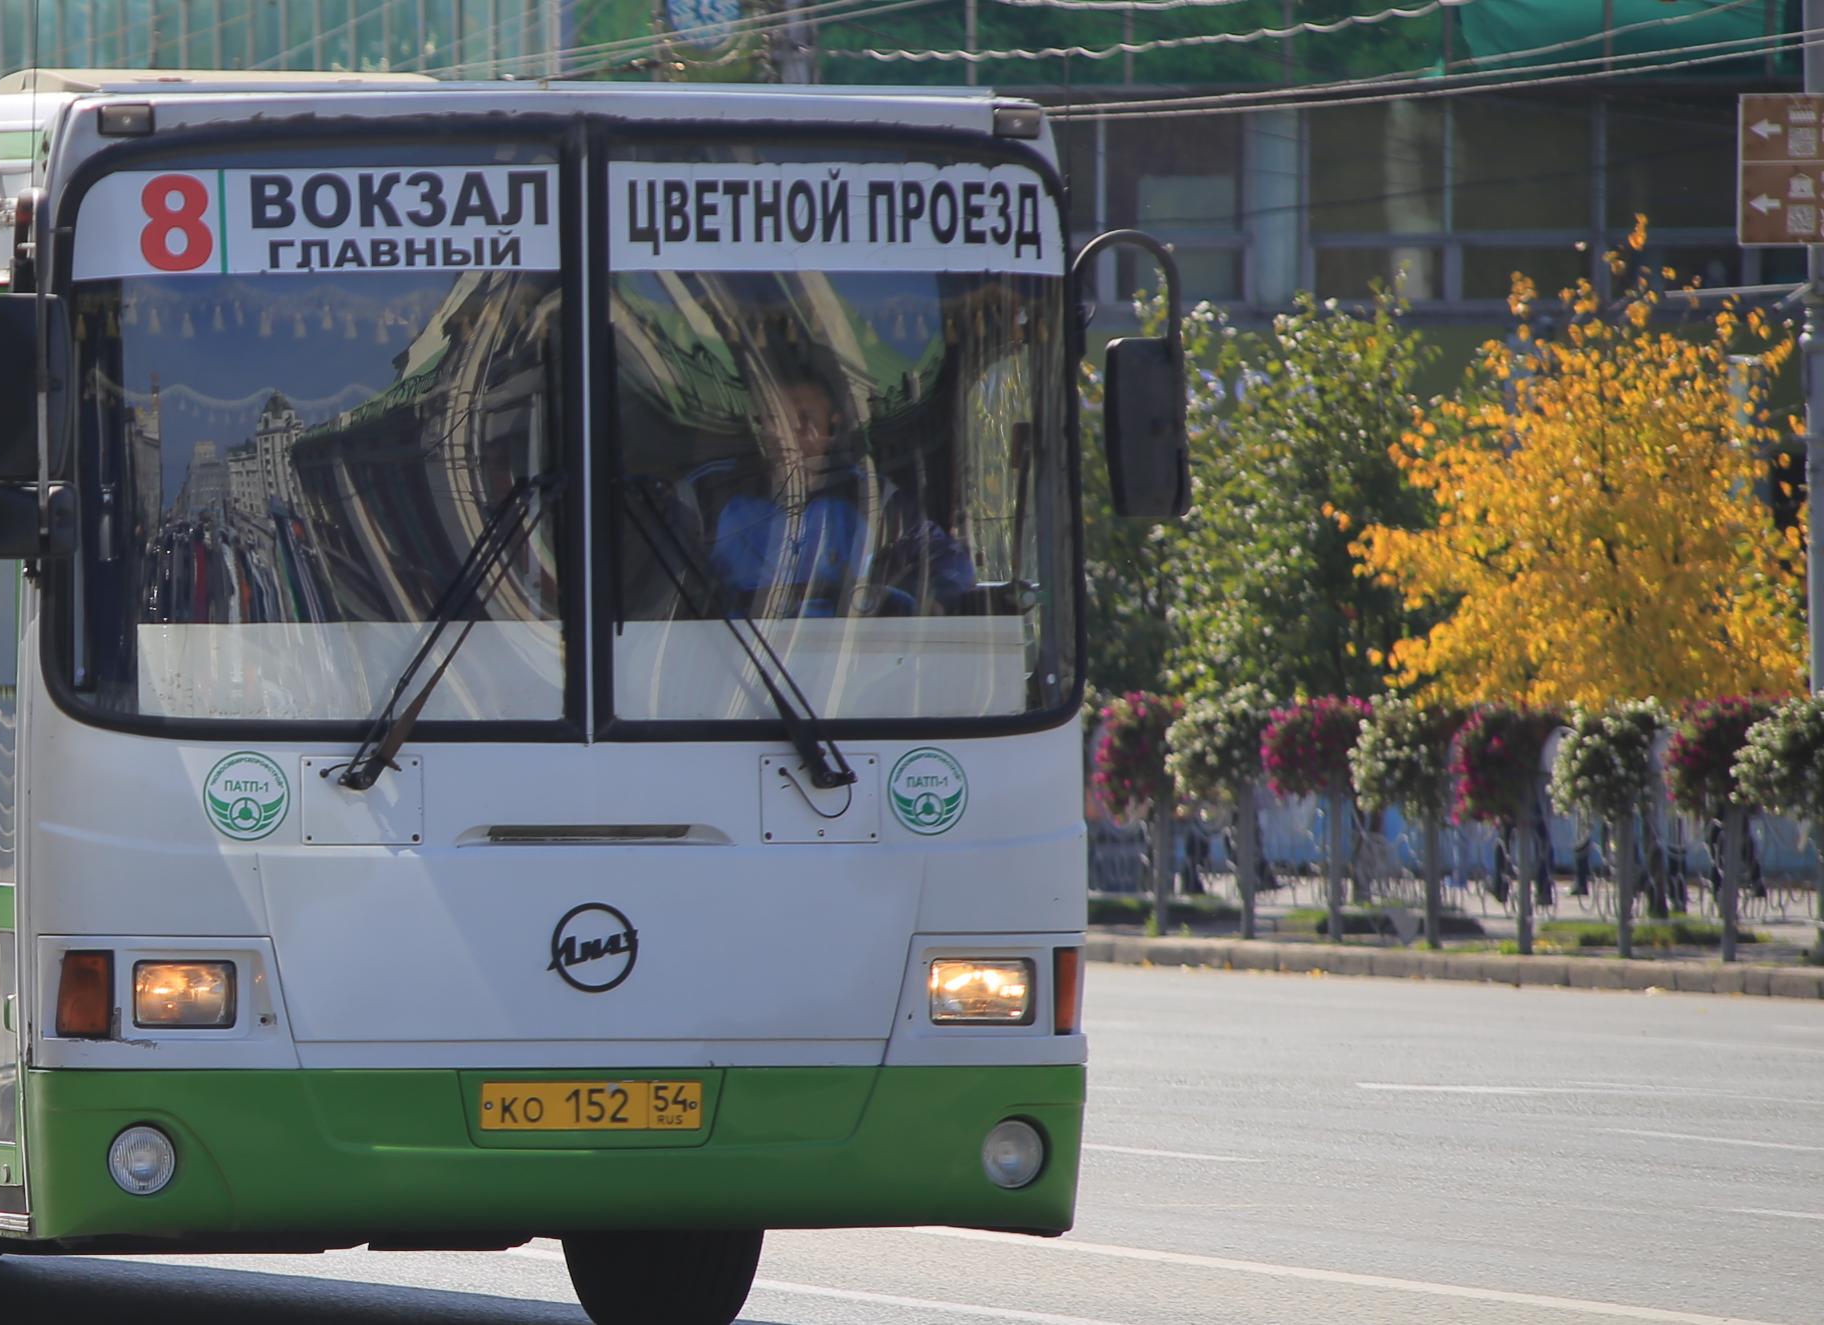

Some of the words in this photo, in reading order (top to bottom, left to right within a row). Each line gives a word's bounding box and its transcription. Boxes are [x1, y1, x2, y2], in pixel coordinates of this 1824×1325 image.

[249, 169, 549, 229] ВОКЗАЛ
[628, 167, 850, 256] ЦВЕТНОЙ
[868, 179, 1043, 260] ПРОЕЗД
[140, 173, 213, 272] 8
[268, 230, 521, 269] ГЛАВНЫЙ
[224, 780, 269, 792] ПАТП-1
[906, 776, 949, 788] ПАТП-1
[500, 1096, 544, 1123] КО
[565, 1088, 629, 1123] 152
[654, 1085, 688, 1113] 54
[657, 1114, 683, 1125] RUS
